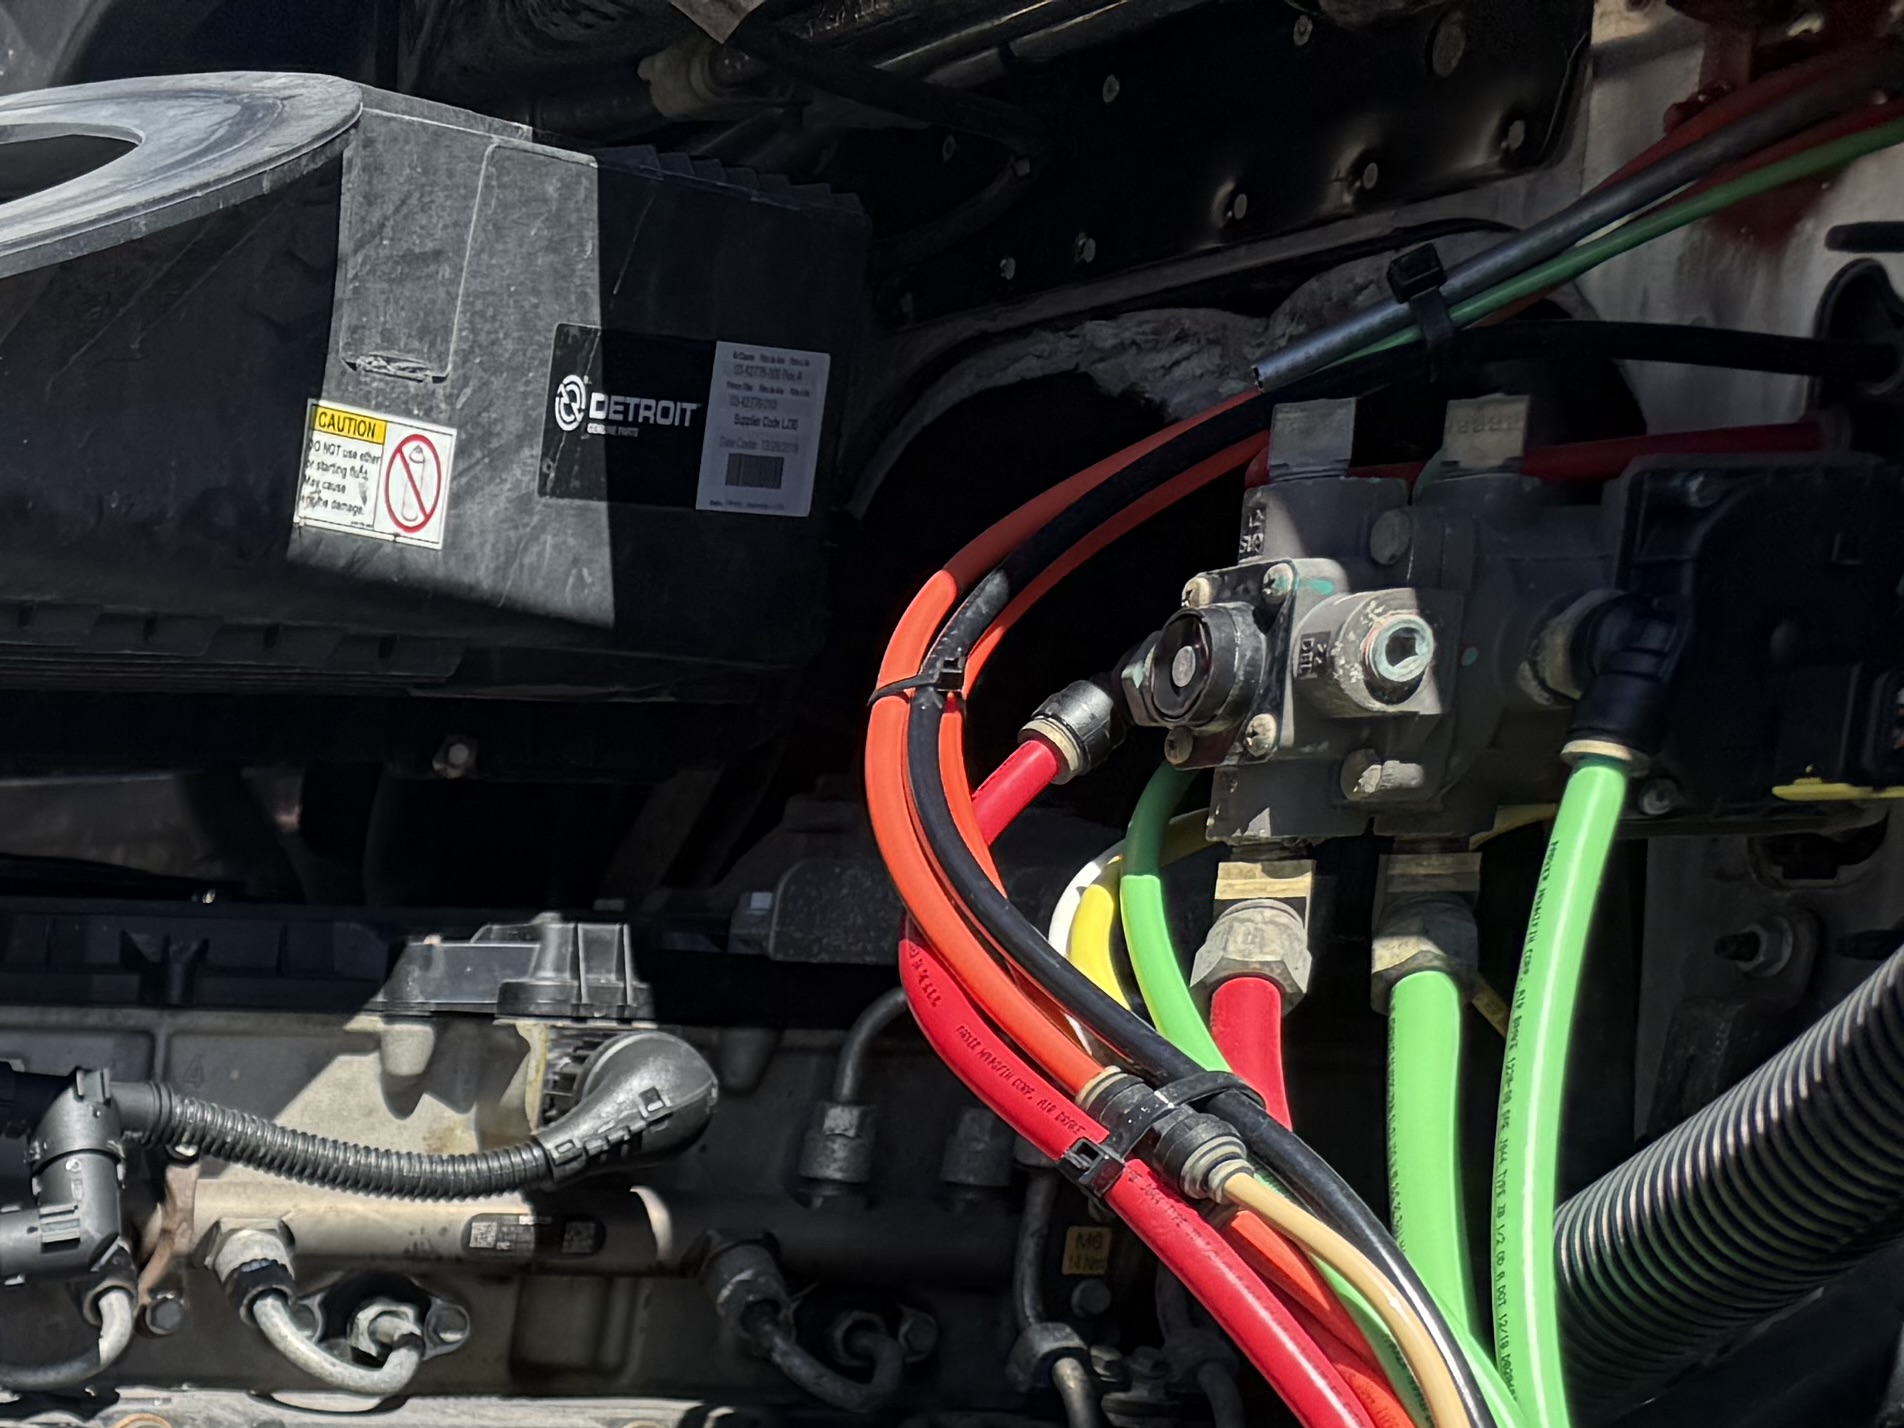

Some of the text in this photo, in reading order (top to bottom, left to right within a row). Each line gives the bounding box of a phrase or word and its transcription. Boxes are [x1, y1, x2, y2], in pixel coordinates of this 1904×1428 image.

[588, 392, 700, 427] DETROIT
[318, 412, 375, 438] CAUTION
[324, 442, 340, 456] NOT
[343, 449, 357, 459] use
[316, 462, 348, 479] starting
[322, 480, 346, 493] cause
